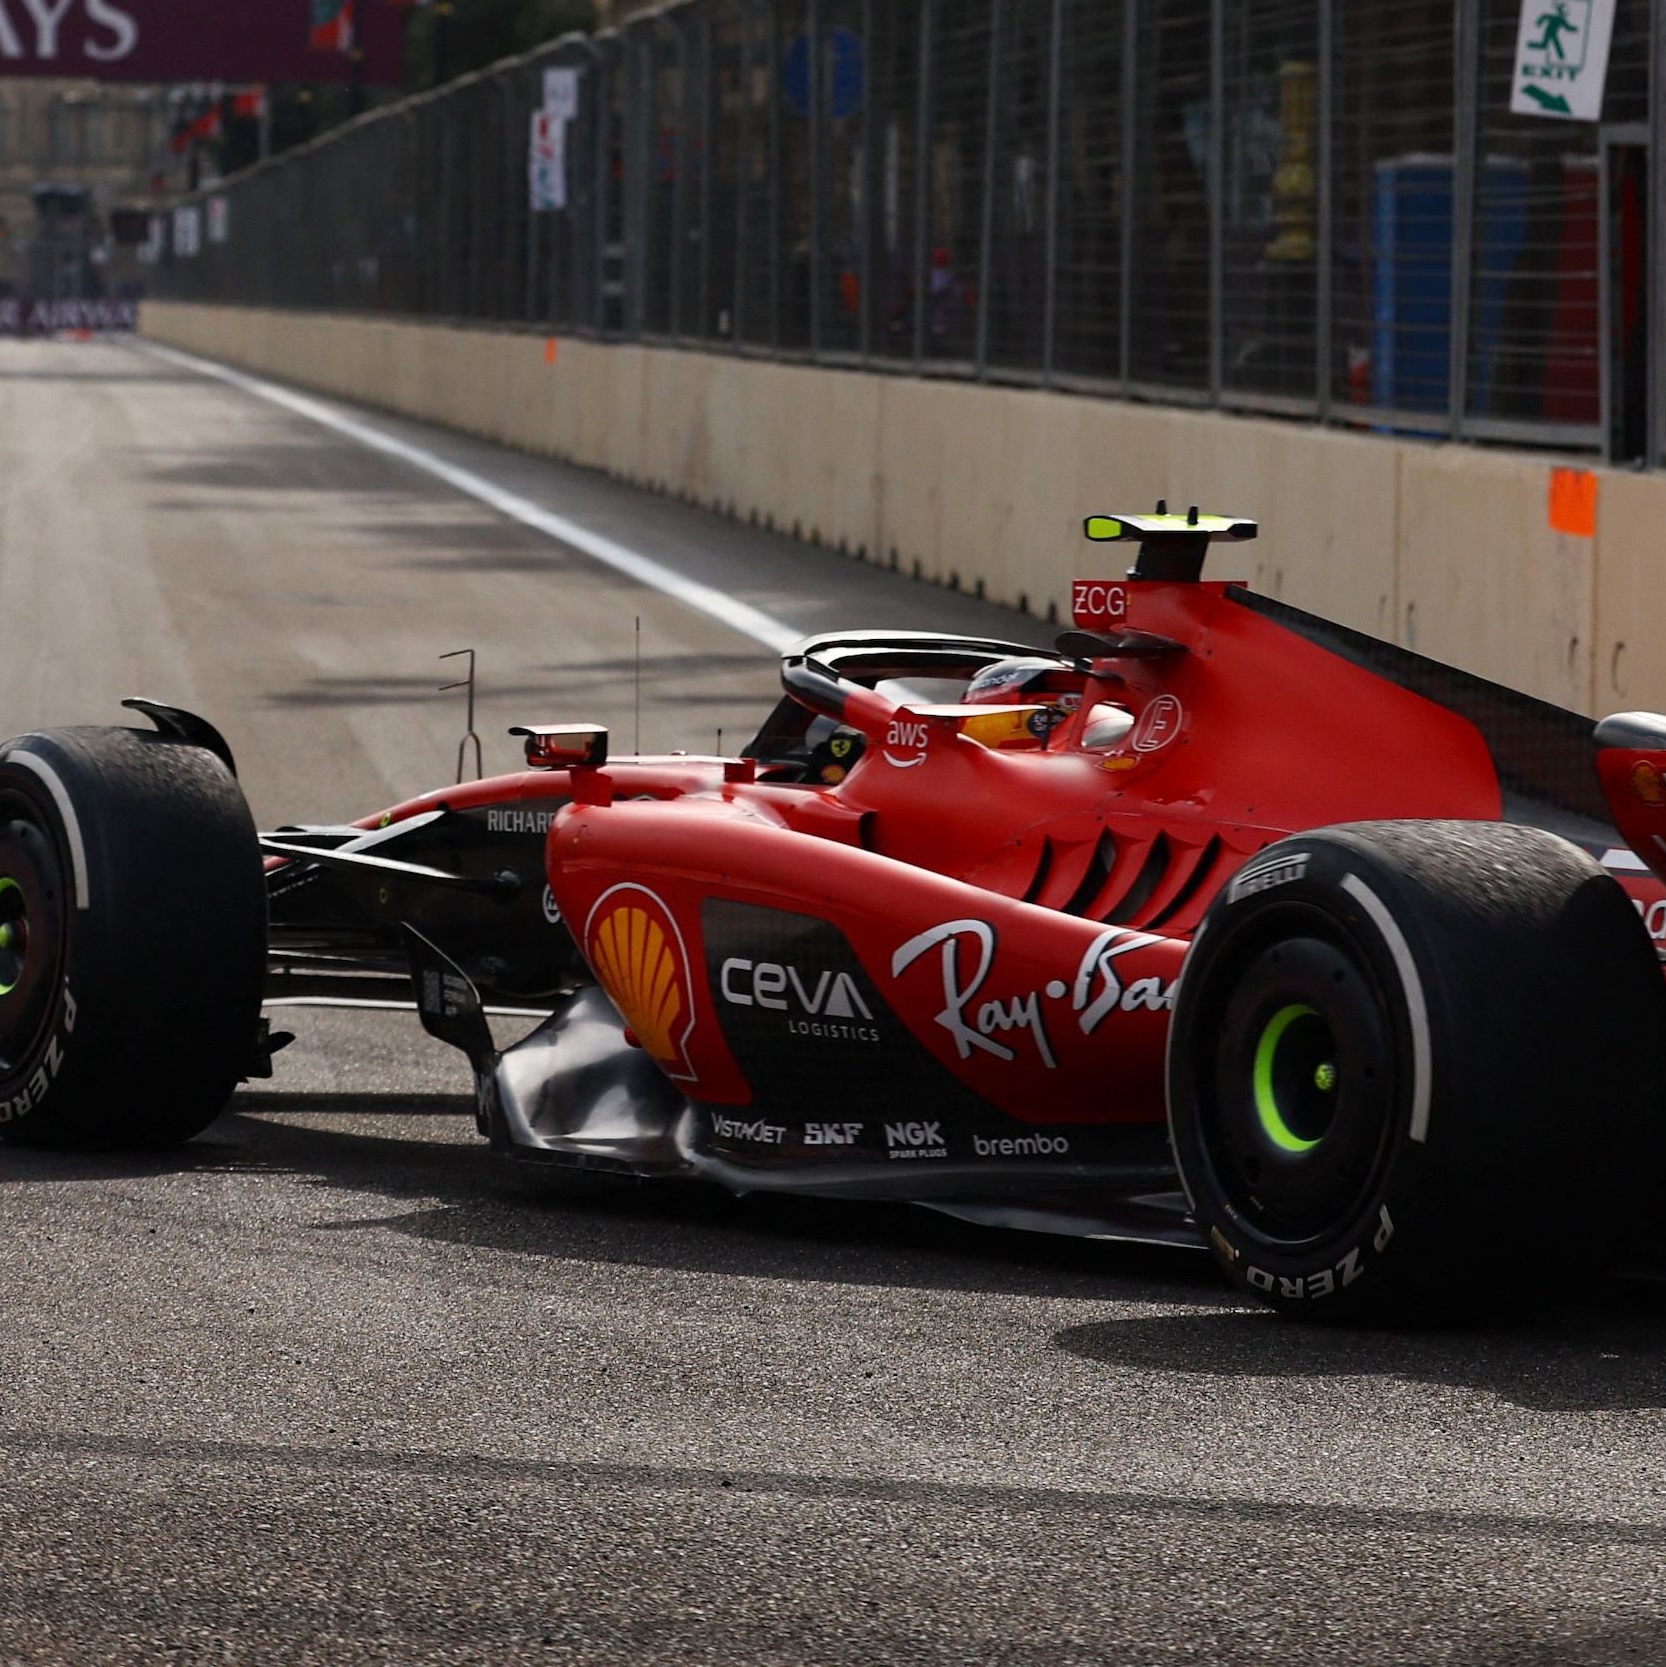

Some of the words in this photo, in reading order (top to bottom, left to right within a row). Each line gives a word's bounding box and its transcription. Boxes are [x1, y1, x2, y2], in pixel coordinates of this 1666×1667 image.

[1521, 63, 1582, 82] EXIT
[886, 720, 929, 749] aws
[787, 1019, 881, 1042] LOGISTICS
[803, 1122, 865, 1145] SKF
[884, 1120, 945, 1146] NGK
[889, 1149, 917, 1159] SPARK
[918, 1147, 948, 1159] PLUGS
[973, 1134, 1070, 1156] brembo
[1245, 1246, 1365, 1300] ZERO
